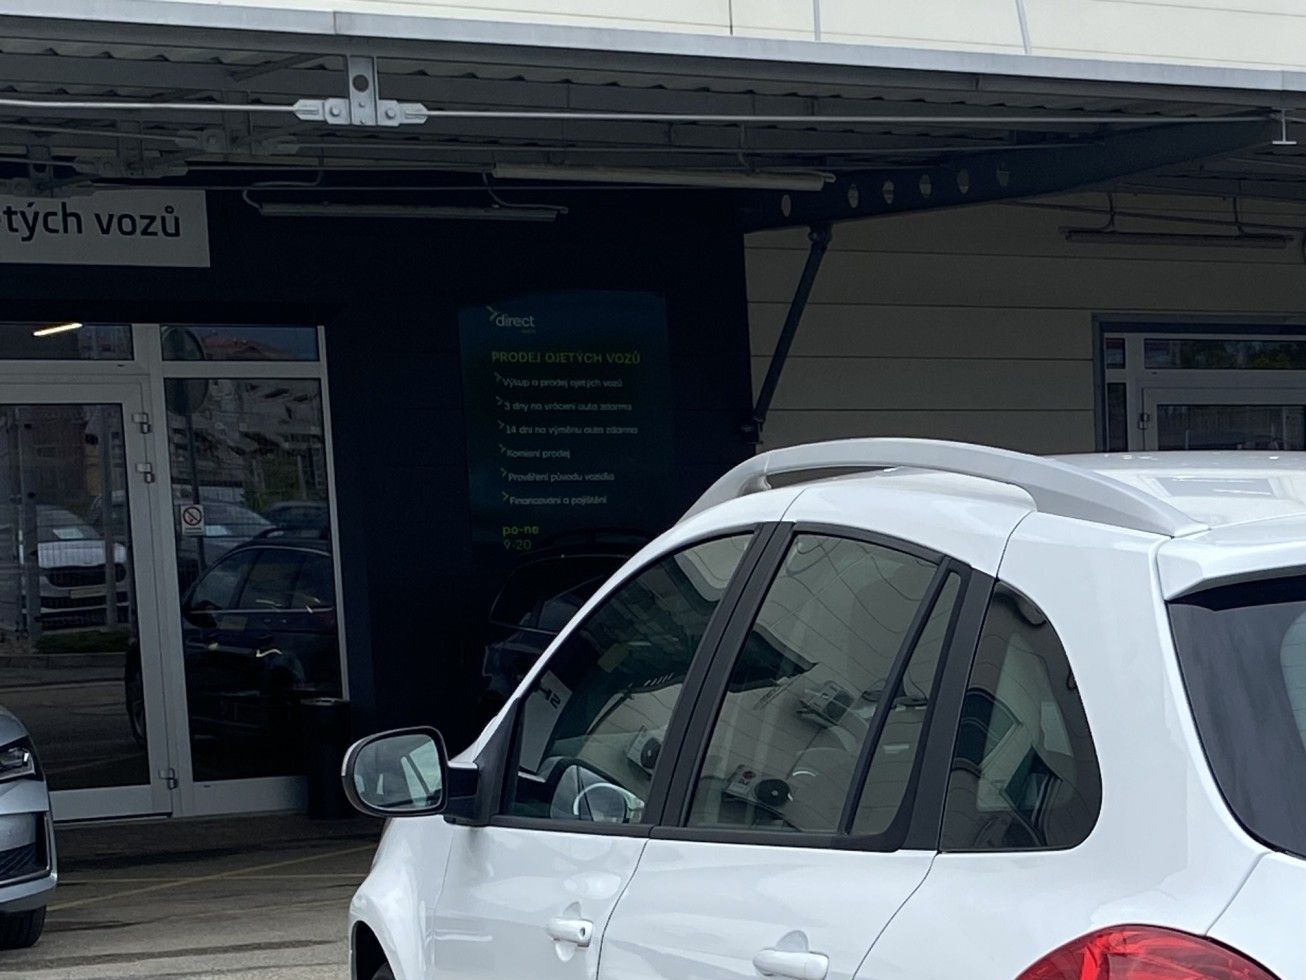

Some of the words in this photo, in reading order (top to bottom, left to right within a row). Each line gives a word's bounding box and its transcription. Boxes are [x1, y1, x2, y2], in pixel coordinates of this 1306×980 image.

[0, 201, 83, 242] tých
[94, 205, 181, 238] vozů
[495, 313, 536, 328] direct
[491, 351, 541, 364] PRODEJ
[545, 349, 602, 364] OJETÝCH
[605, 349, 640, 365] VOZŮ
[540, 379, 569, 389] prodej
[504, 401, 511, 411] 3
[512, 401, 529, 412] dny
[530, 403, 542, 411] na
[505, 425, 517, 434] 14
[535, 426, 546, 434] na
[542, 450, 571, 459] prodej
[502, 526, 539, 537] po-ne
